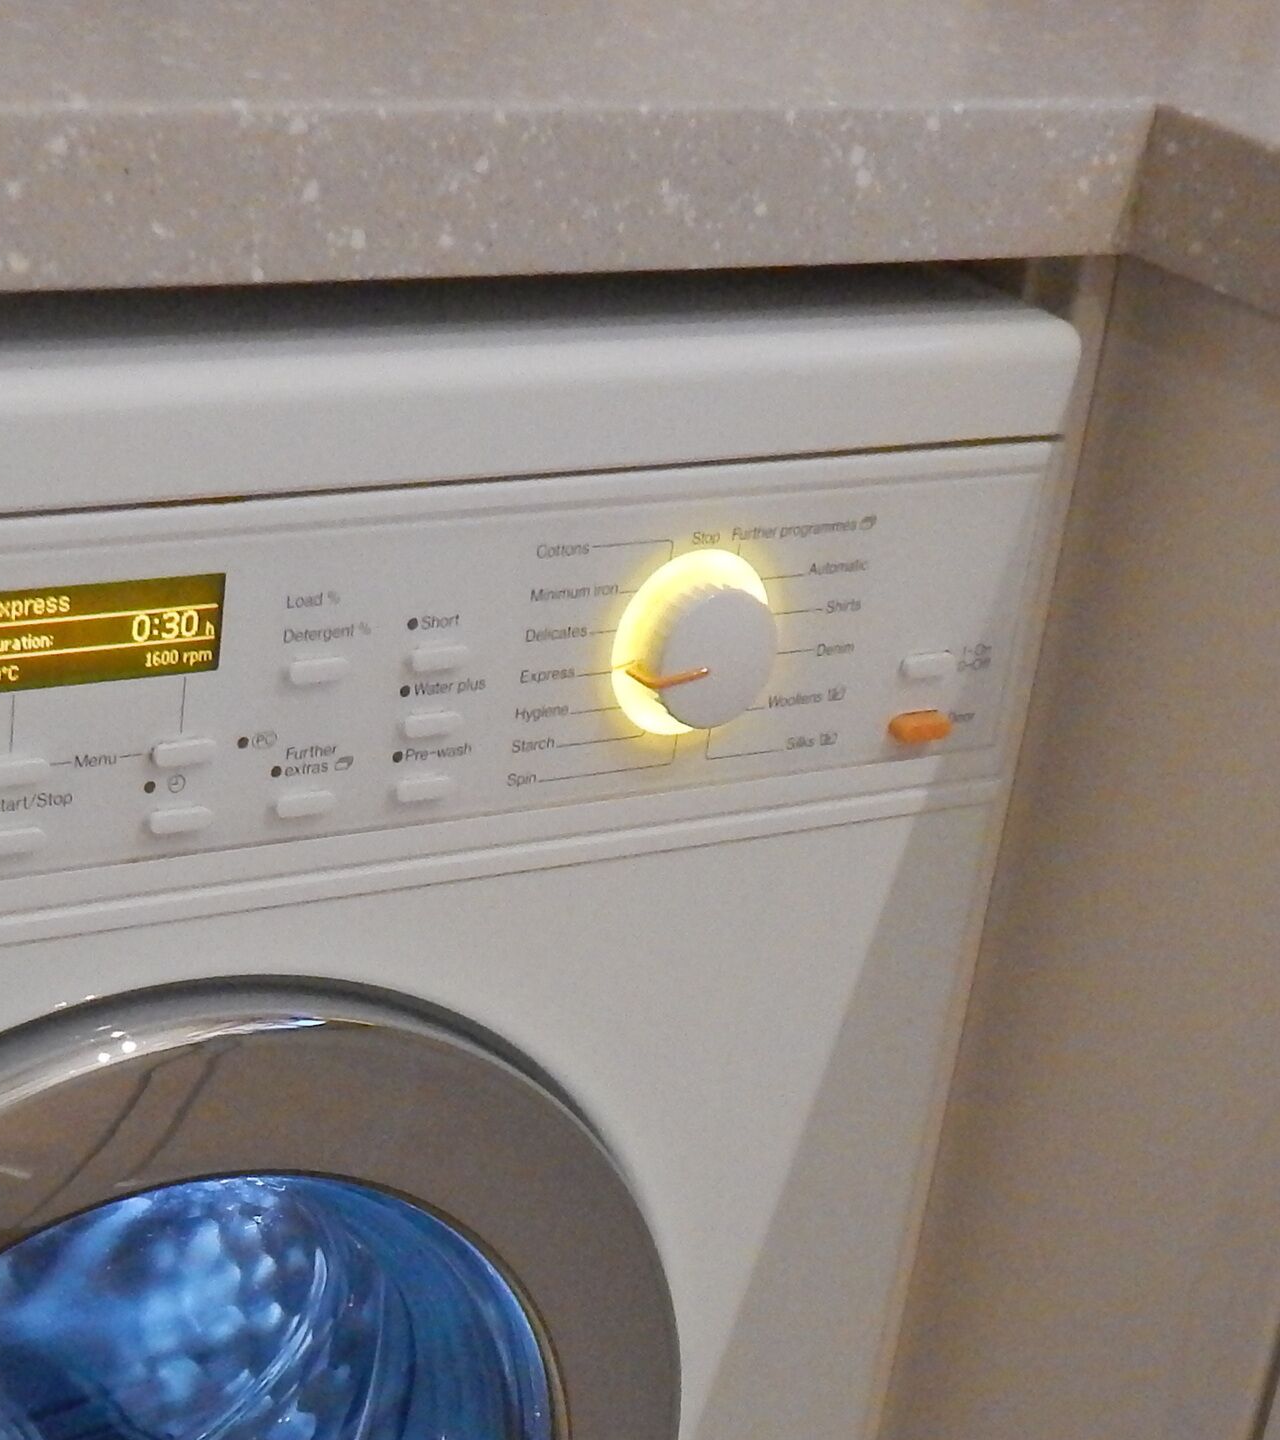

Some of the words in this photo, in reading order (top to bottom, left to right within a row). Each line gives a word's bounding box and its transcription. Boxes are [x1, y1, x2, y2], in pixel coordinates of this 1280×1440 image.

[732, 525, 777, 541] Further
[780, 517, 857, 539] programmes
[691, 531, 720, 545] Stop
[536, 543, 590, 559] Cottons
[808, 559, 868, 575] Automatic
[286, 592, 323, 609] Load
[530, 587, 591, 602] Minimum
[594, 583, 619, 598] iron
[825, 599, 862, 614] Shirts
[132, 609, 198, 643] 0:30
[205, 619, 215, 636] h
[420, 614, 460, 631] Short
[282, 624, 355, 644] Detergent
[525, 626, 588, 643] Delicates
[816, 643, 855, 657] Denim
[145, 650, 179, 667] 1600
[182, 650, 212, 664] rpm
[520, 668, 575, 684] Express
[414, 681, 453, 697] Water
[457, 678, 486, 694] plus
[515, 703, 569, 720] Hygiene
[285, 744, 337, 760] Further
[405, 743, 472, 762] Pre-wash
[511, 737, 555, 753] Starch
[73, 753, 117, 768] Menu
[284, 761, 329, 777] extras
[506, 772, 537, 788] Spin
